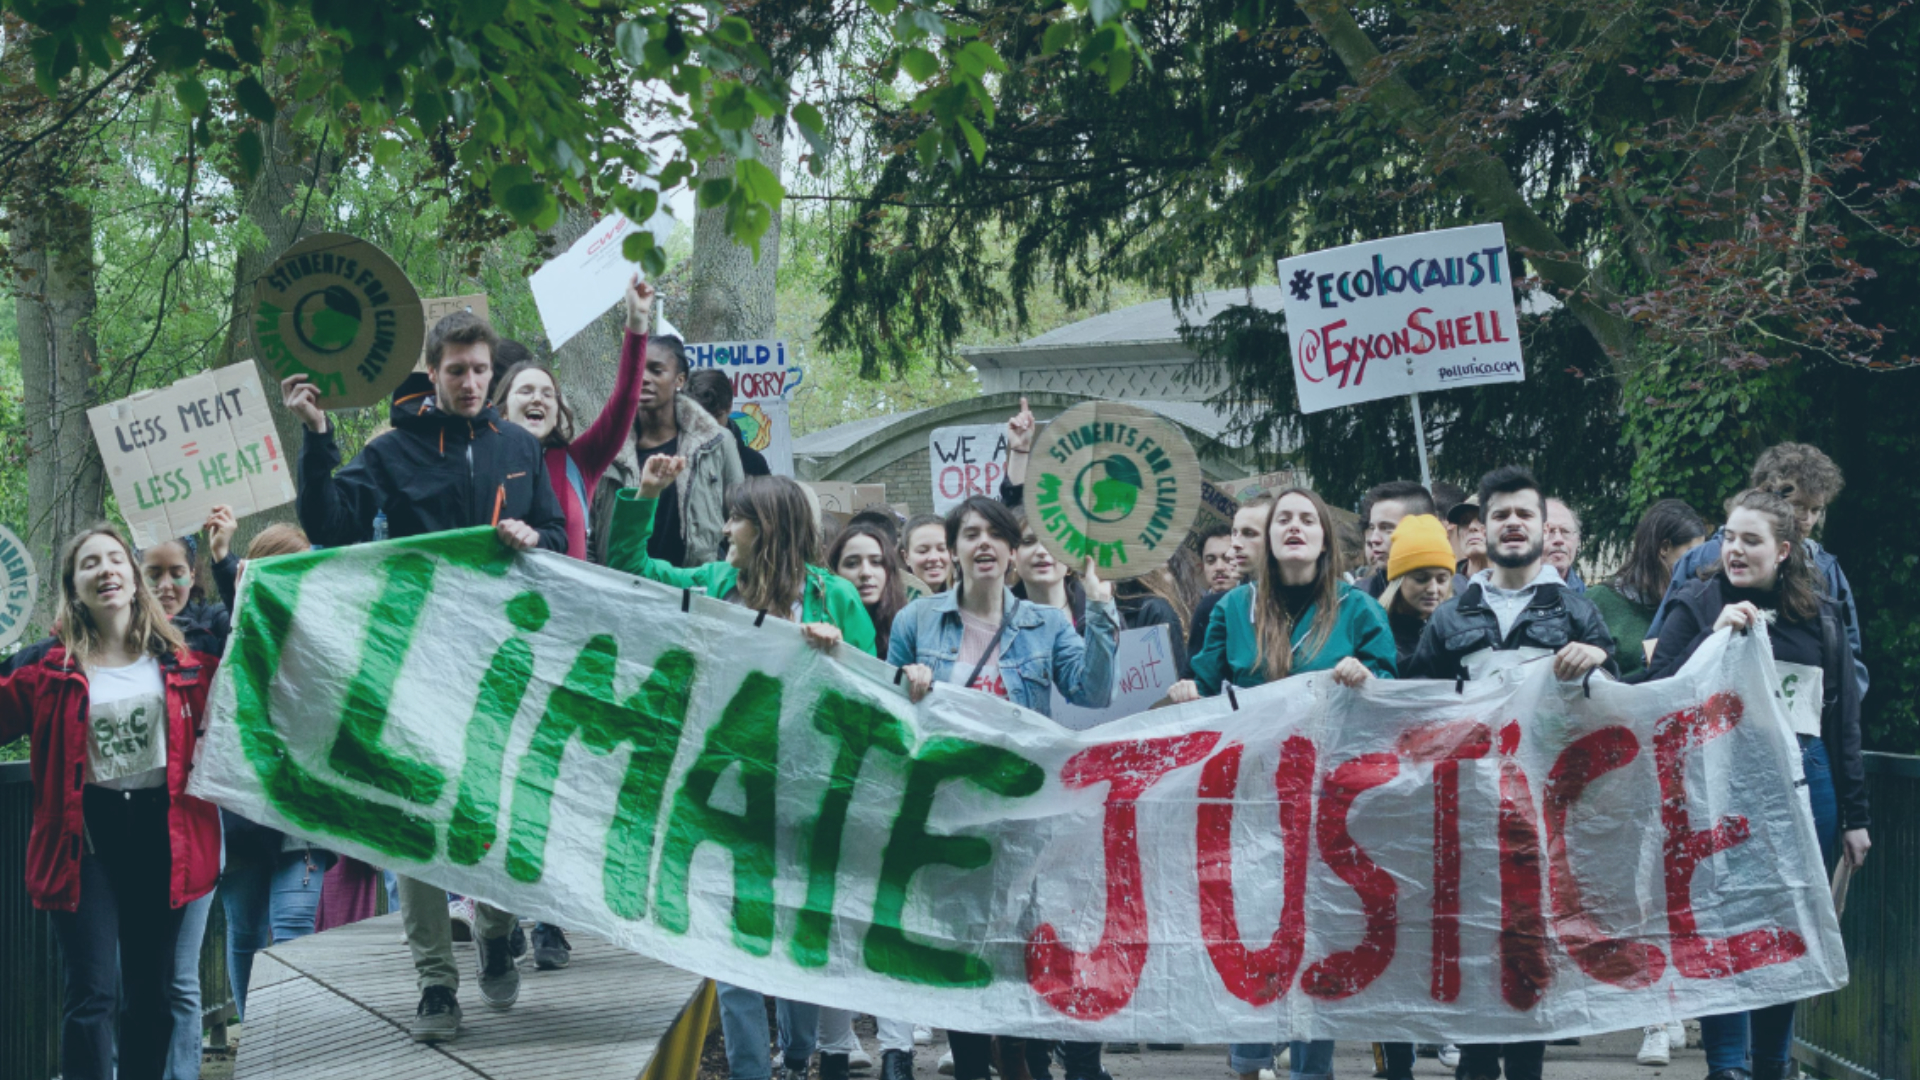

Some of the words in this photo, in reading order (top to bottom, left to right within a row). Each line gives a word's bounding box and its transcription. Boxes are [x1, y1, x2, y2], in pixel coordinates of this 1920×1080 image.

[268, 252, 358, 293] STUDENTS
[354, 269, 390, 307] FOR
[429, 301, 464, 319] ET'S
[357, 309, 396, 384] CLIMATE
[684, 344, 770, 368] SHOULD
[115, 415, 168, 454] LESS
[177, 388, 243, 433] MEAT
[934, 435, 976, 463] WE
[1049, 422, 1138, 463] STUDENTS
[1136, 436, 1172, 475] FOR
[133, 467, 192, 511] LESS
[198, 434, 279, 490] HEAT!
[1138, 476, 1177, 551] CLIMATE
[1119, 643, 1163, 693] wait
